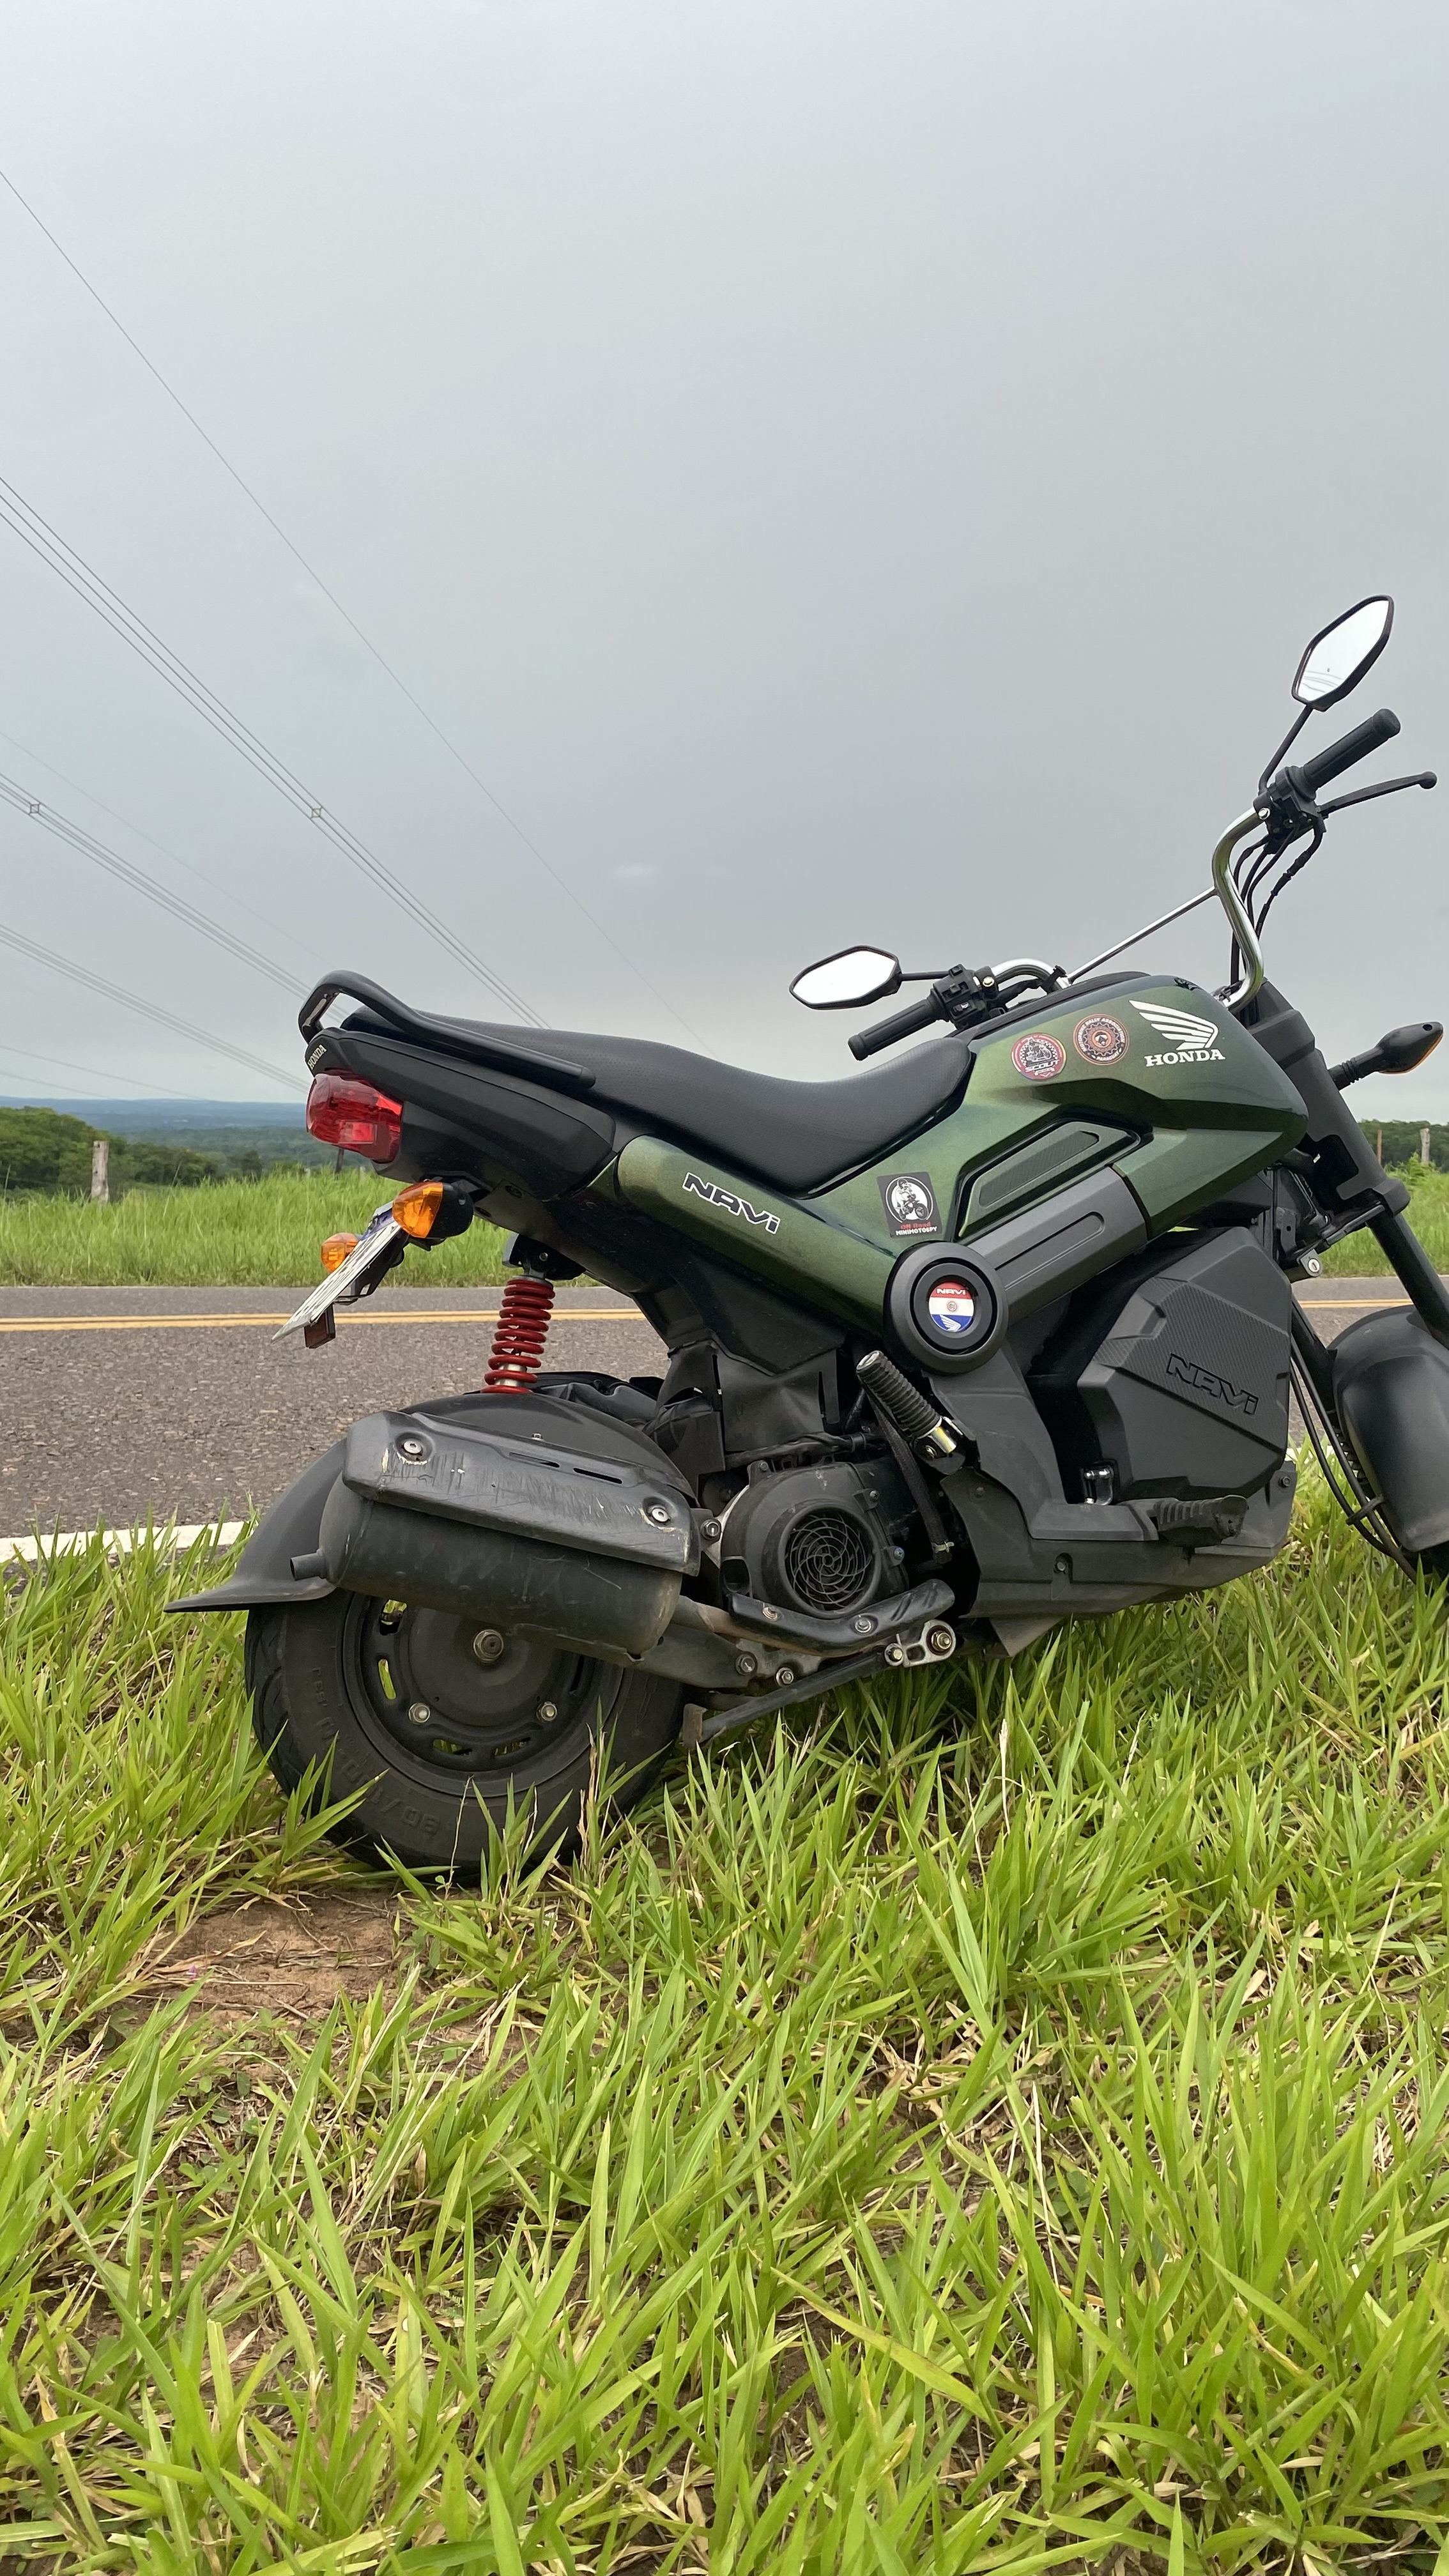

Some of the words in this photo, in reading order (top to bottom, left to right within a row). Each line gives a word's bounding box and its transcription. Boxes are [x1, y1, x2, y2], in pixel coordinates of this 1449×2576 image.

[1078, 1023, 1088, 1052] MOTORBIKE
[1085, 1018, 1100, 1026] RALLY
[1101, 1018, 1125, 1043] ASSOCIATION
[307, 1045, 327, 1070] HONDA
[1096, 1050, 1119, 1061] PARAGUAY
[1144, 1049, 1225, 1067] HONDA
[1025, 1059, 1061, 1072] SCOUT
[896, 1226, 937, 1236] MINIMOTOSPY
